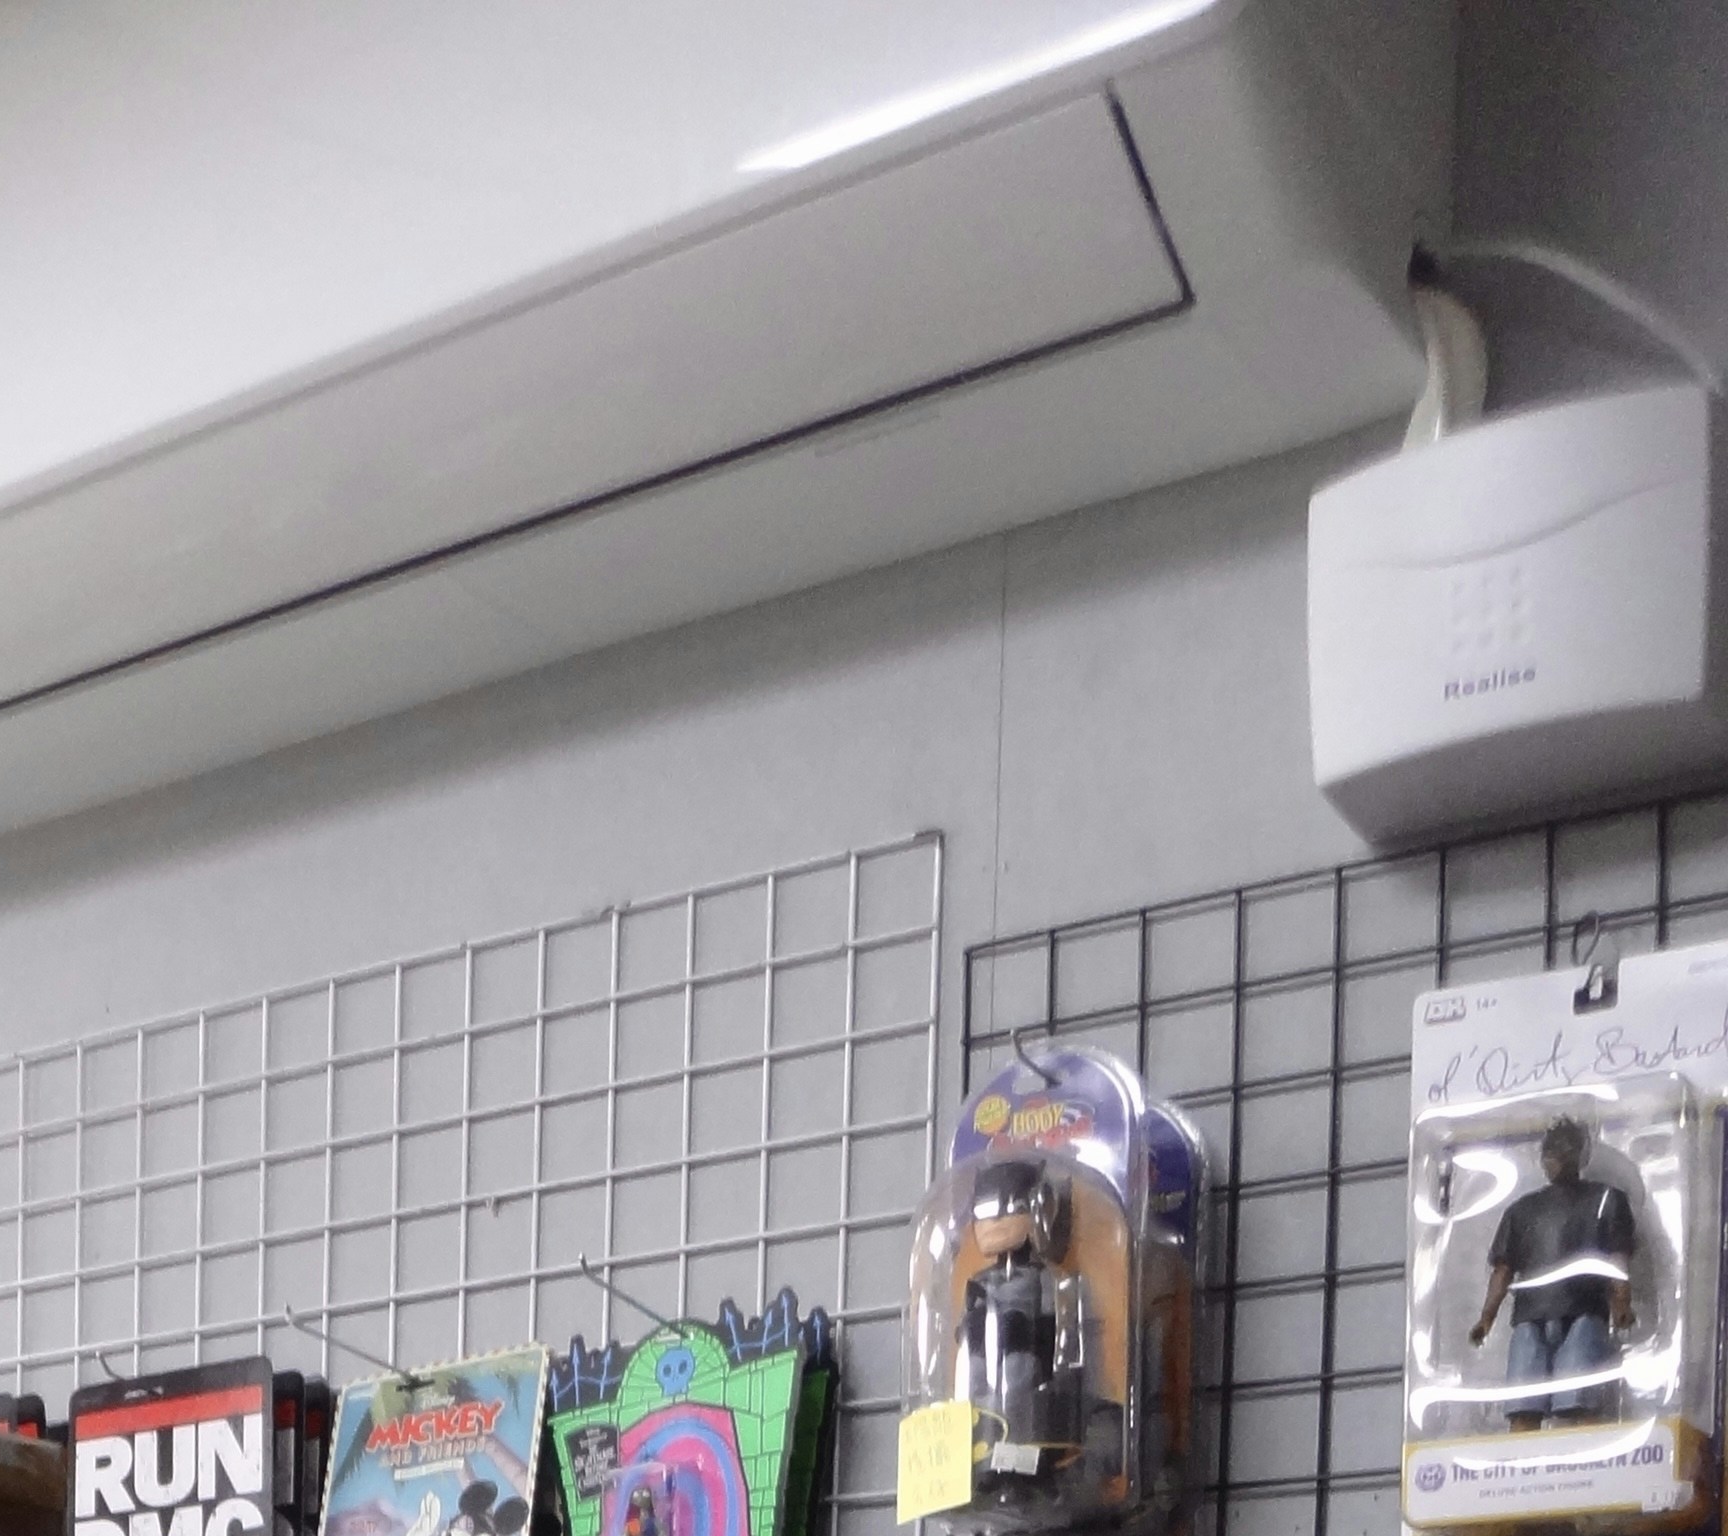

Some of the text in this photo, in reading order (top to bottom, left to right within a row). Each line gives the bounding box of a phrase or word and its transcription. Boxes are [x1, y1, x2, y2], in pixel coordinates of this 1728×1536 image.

[365, 1400, 506, 1453] MICKEY
[73, 1412, 264, 1519] RUN
[1630, 1443, 1663, 1465] ZOO
